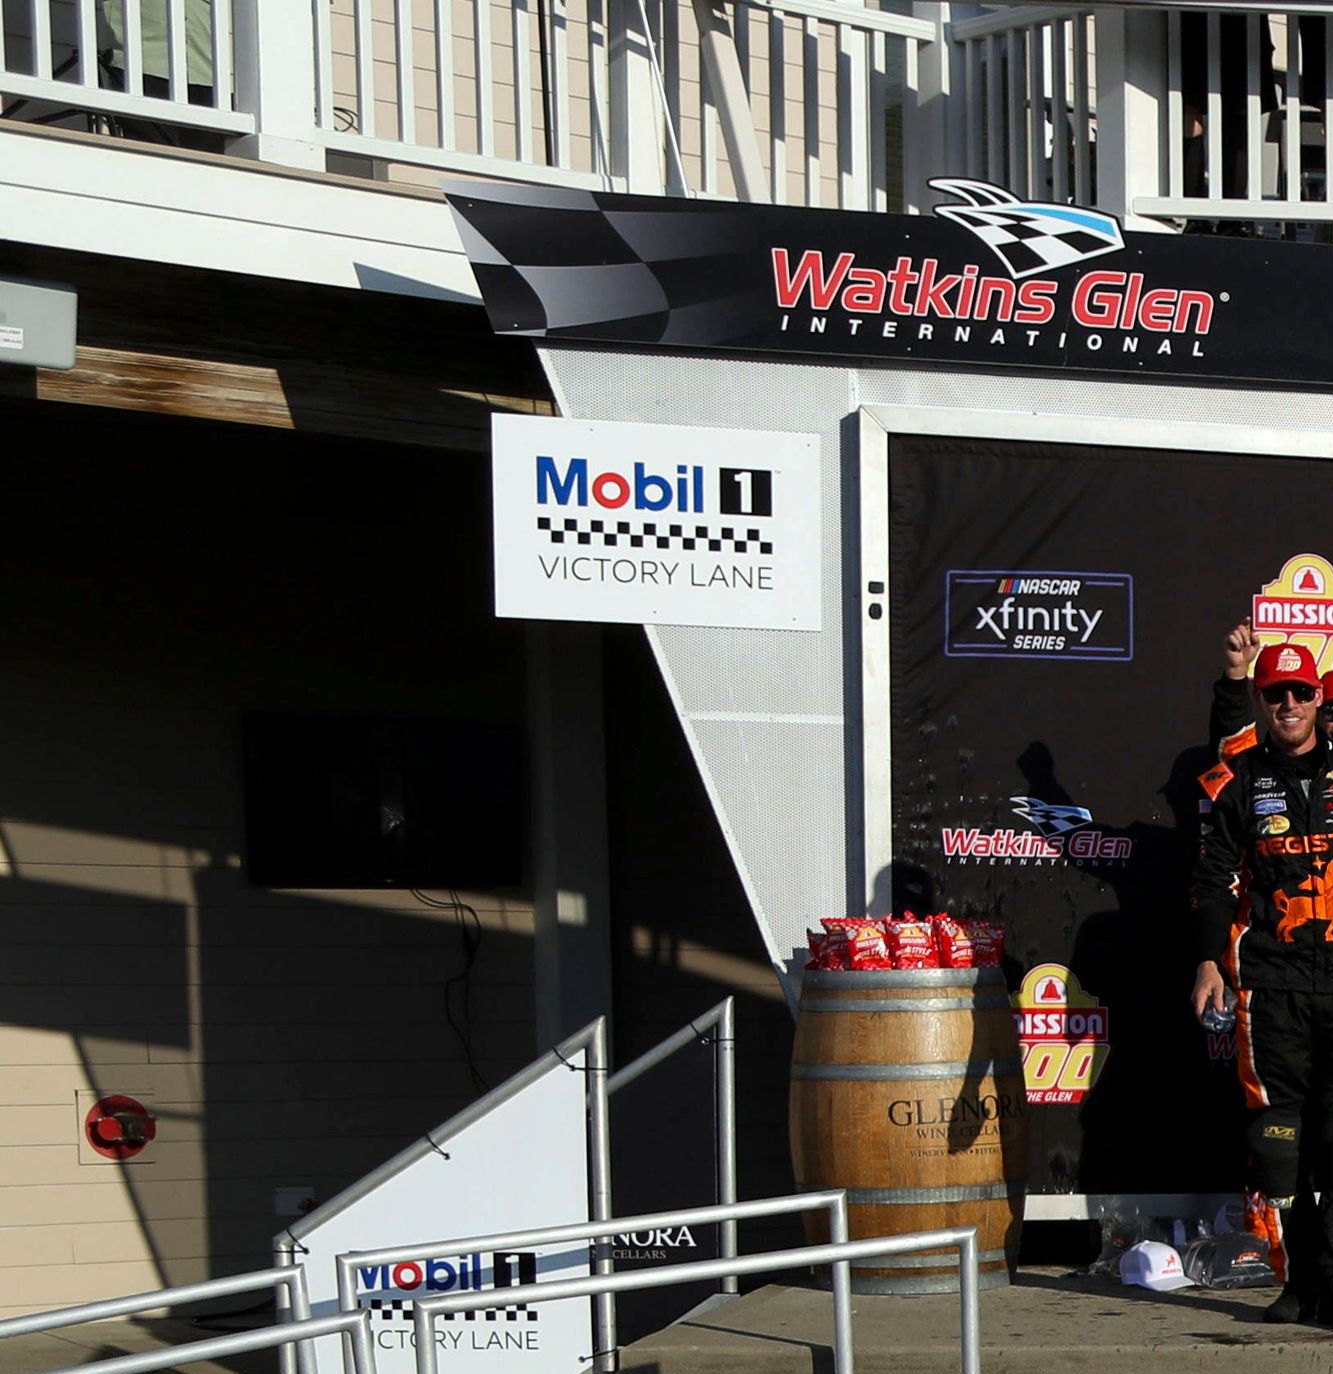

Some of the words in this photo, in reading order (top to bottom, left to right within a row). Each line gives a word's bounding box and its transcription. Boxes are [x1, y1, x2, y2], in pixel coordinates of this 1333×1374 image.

[770, 247, 1060, 325] Watkins
[1073, 268, 1214, 336] Glen
[780, 314, 1204, 358] INTERNATIONAL
[536, 456, 703, 514] Mobil
[538, 554, 679, 588] VICTORY
[690, 563, 773, 590] LANE
[1016, 579, 1081, 596] NASCAR
[977, 598, 1103, 642] xfinity
[1012, 634, 1065, 651] SERIES
[942, 828, 1064, 858] Watkins
[1069, 831, 1132, 858] Glen
[947, 857, 1127, 867] INTERNATIONAL
[1019, 1043, 1111, 1090] 00
[888, 1095, 1024, 1127] GLENORA
[1045, 1092, 1073, 1102] GLEN
[613, 1250, 666, 1259] CELLARS
[471, 1330, 538, 1350] LANE
